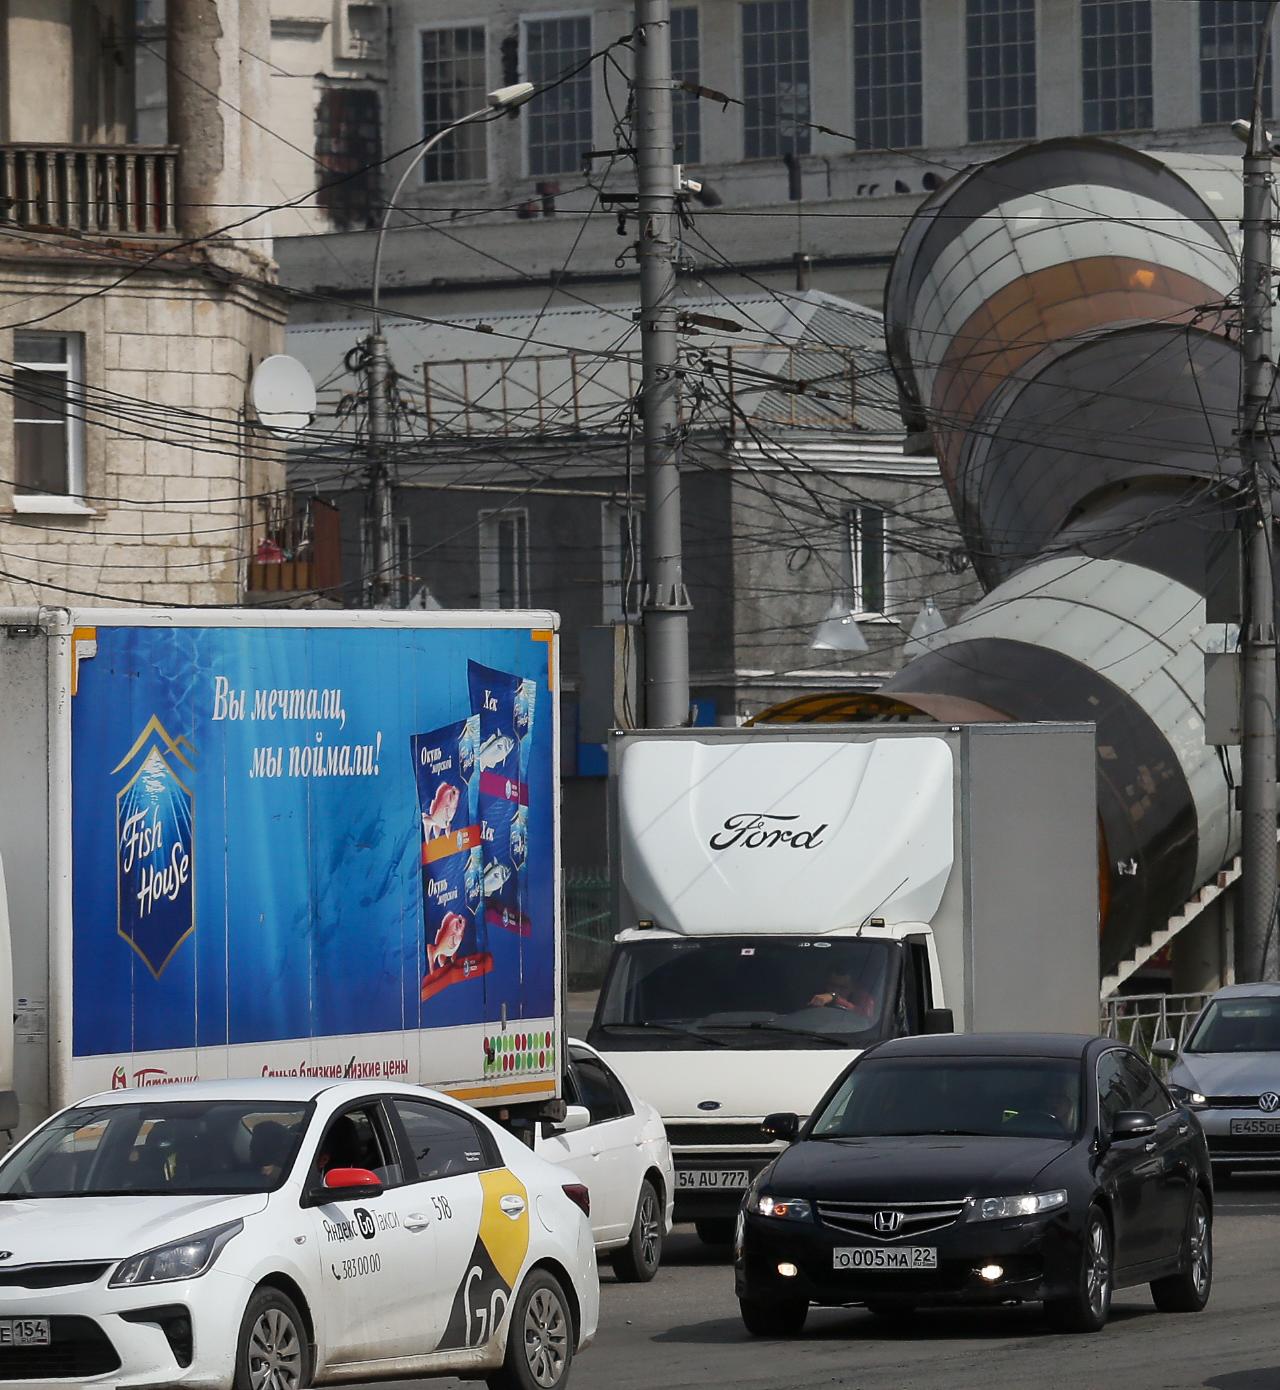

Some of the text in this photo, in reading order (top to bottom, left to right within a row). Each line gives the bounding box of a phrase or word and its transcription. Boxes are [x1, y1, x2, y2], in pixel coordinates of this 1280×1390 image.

[212, 675, 346, 731] Вы мечтали,
[483, 689, 498, 712] Хек
[250, 731, 383, 778] мы поймали!
[124, 804, 163, 873] Fish
[480, 820, 495, 842] Хек
[709, 813, 829, 850] Ford
[383, 1059, 409, 1080] цены
[679, 1172, 745, 1187] 54 AU 777
[430, 1195, 452, 1222] 518
[322, 1210, 400, 1243] Яндекс Go Такси
[342, 1252, 381, 1280] 383 00 00
[914, 1248, 931, 1262] 22
[14, 1321, 47, 1338] 154
